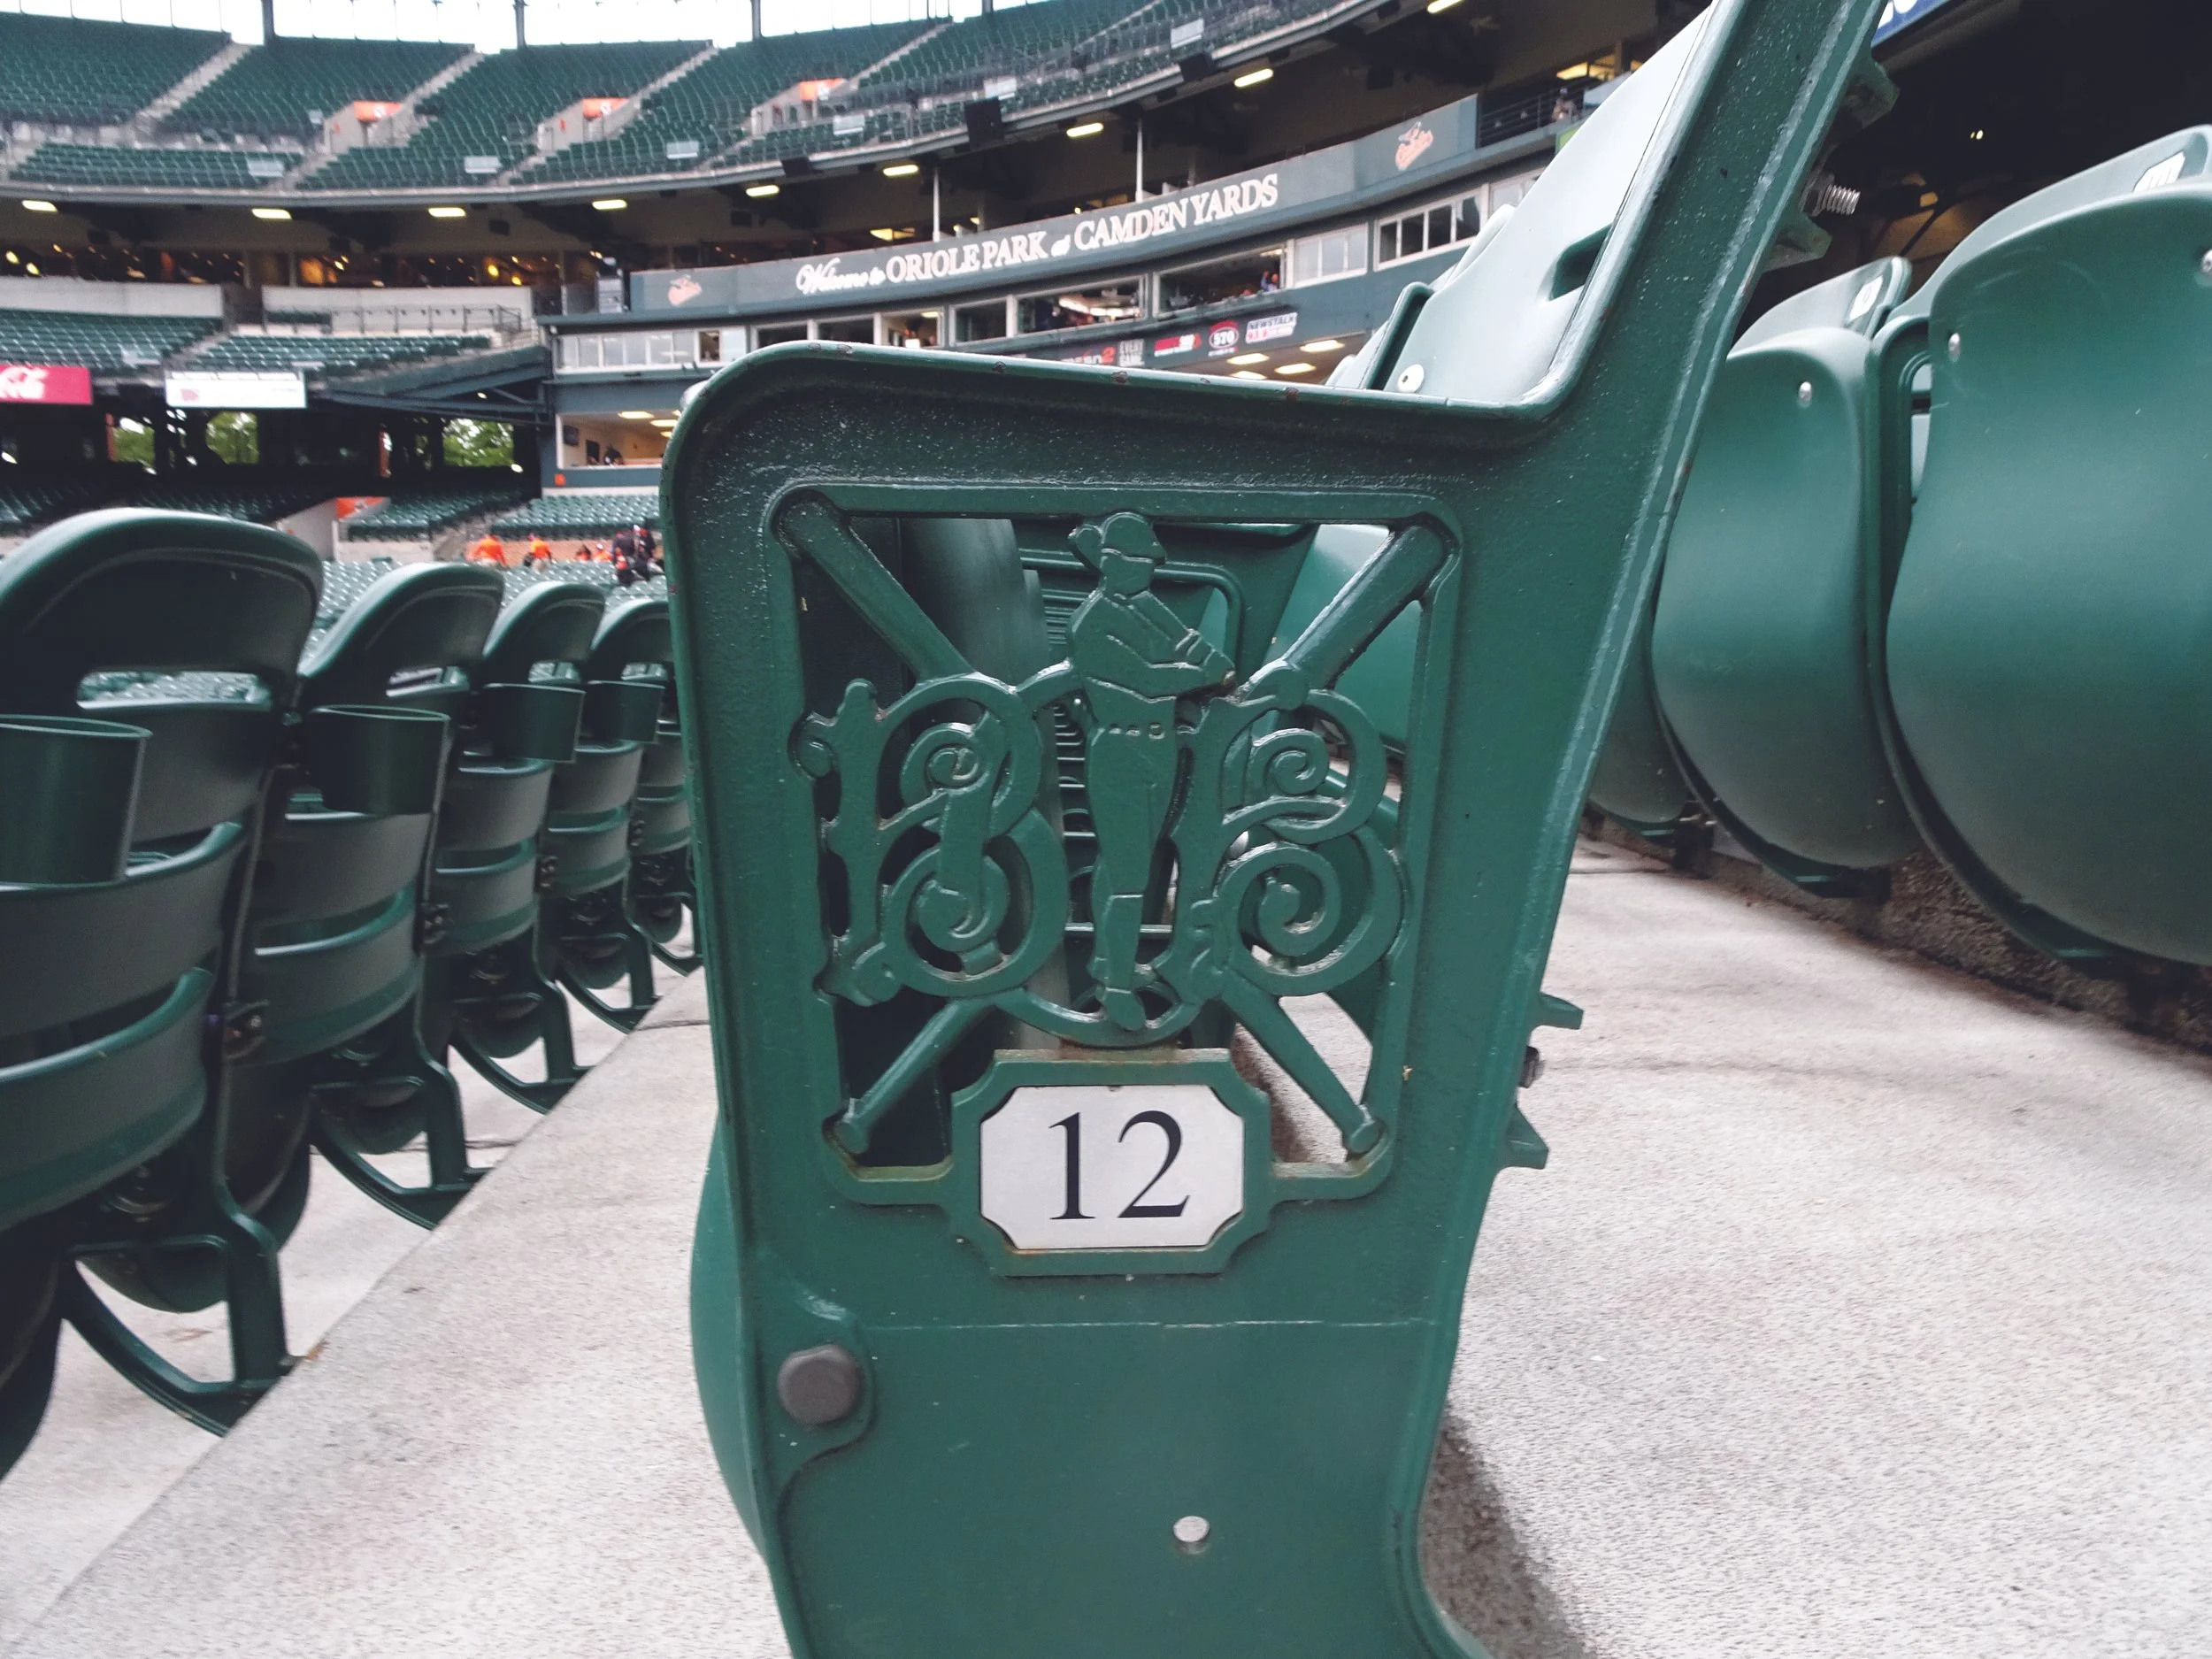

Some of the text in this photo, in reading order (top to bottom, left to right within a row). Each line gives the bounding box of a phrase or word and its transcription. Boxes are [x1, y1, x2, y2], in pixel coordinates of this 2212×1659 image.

[886, 243, 981, 284] ORIOLE
[981, 230, 1049, 270] PARK
[1073, 199, 1189, 251] CAMDEN
[1190, 173, 1279, 226] YARDS
[1213, 330, 1235, 346] 570
[1048, 1109, 1191, 1220] 12
